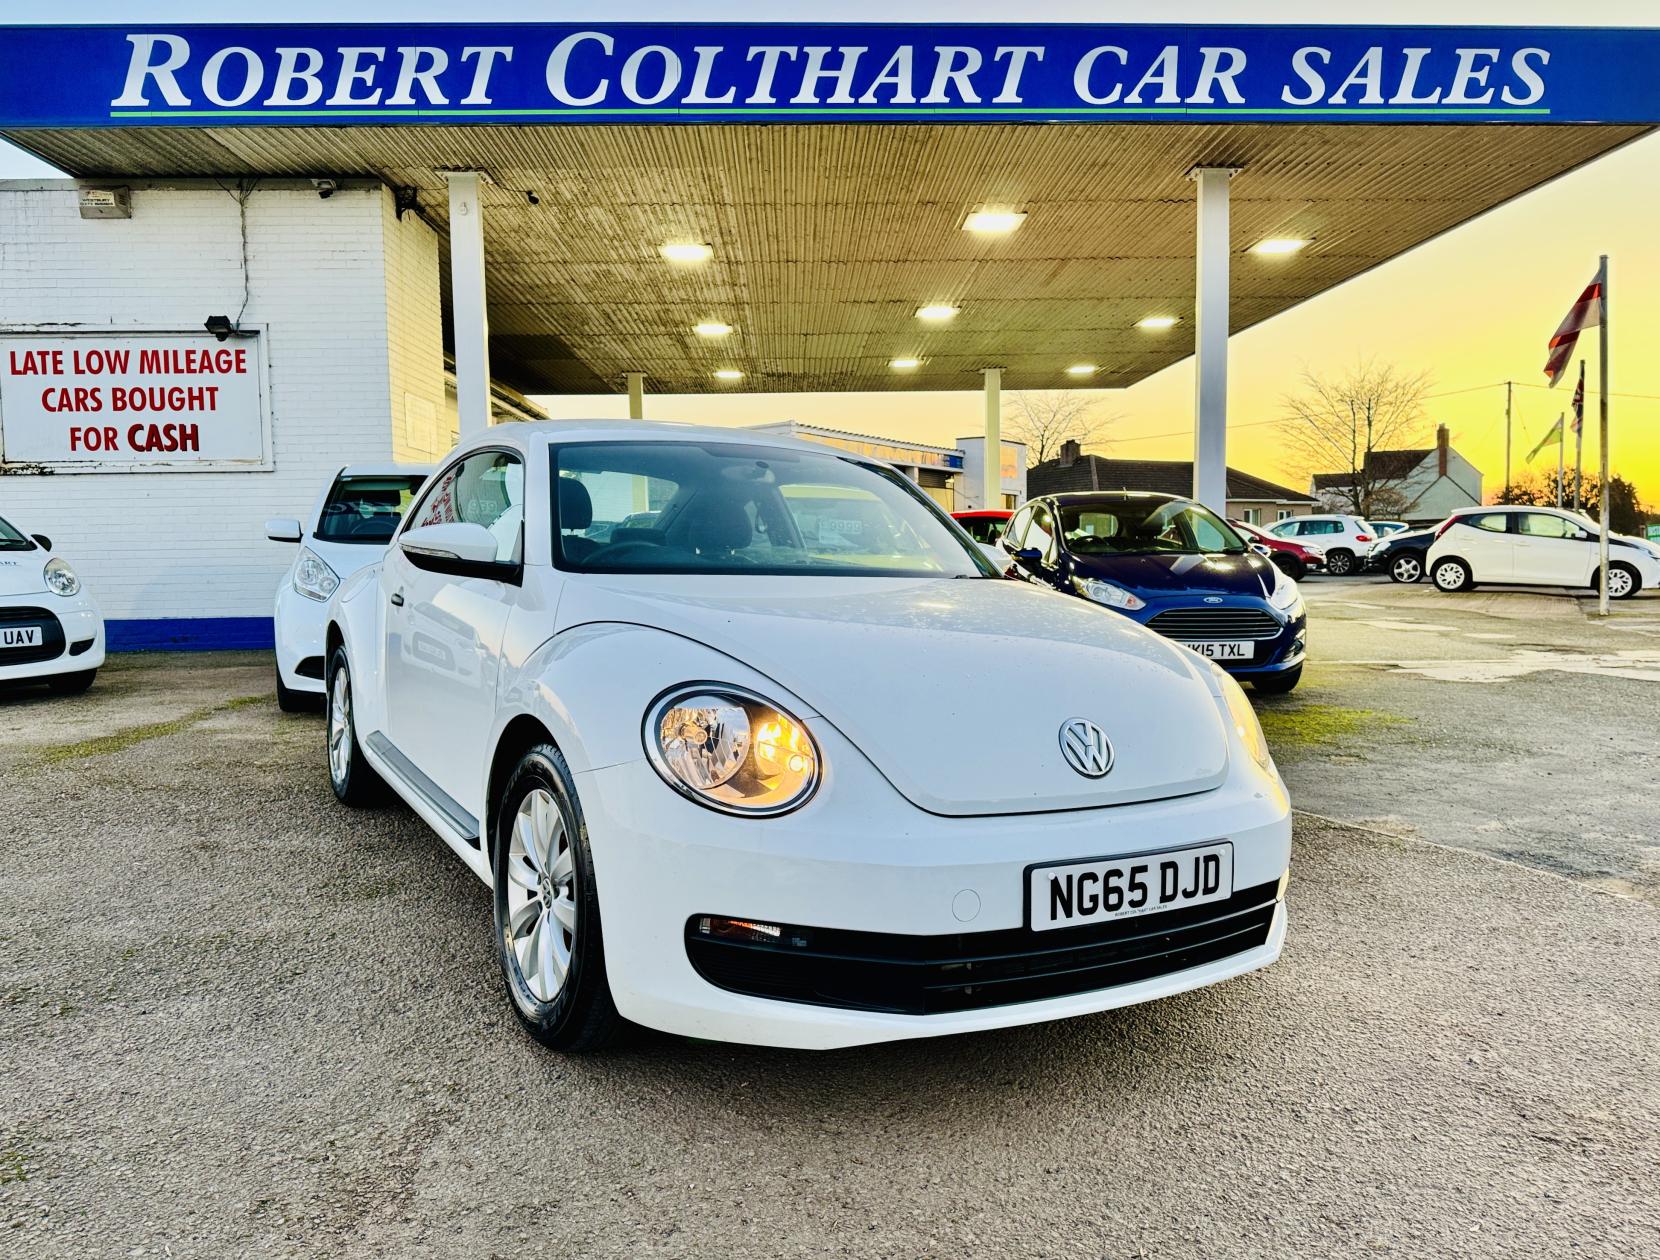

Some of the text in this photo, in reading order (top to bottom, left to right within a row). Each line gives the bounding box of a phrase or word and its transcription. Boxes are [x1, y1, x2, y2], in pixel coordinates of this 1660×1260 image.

[111, 31, 1551, 107] ROBERT COLTHART CAR SALES
[10, 349, 247, 376] LATE LOW MILEAGE
[41, 386, 219, 413] CARS BOUGHT
[69, 423, 200, 452] FOR CASH
[3, 629, 34, 645] UAV
[1184, 643, 1246, 657] K15 TXL
[1049, 853, 1221, 921] NG65 DJD
